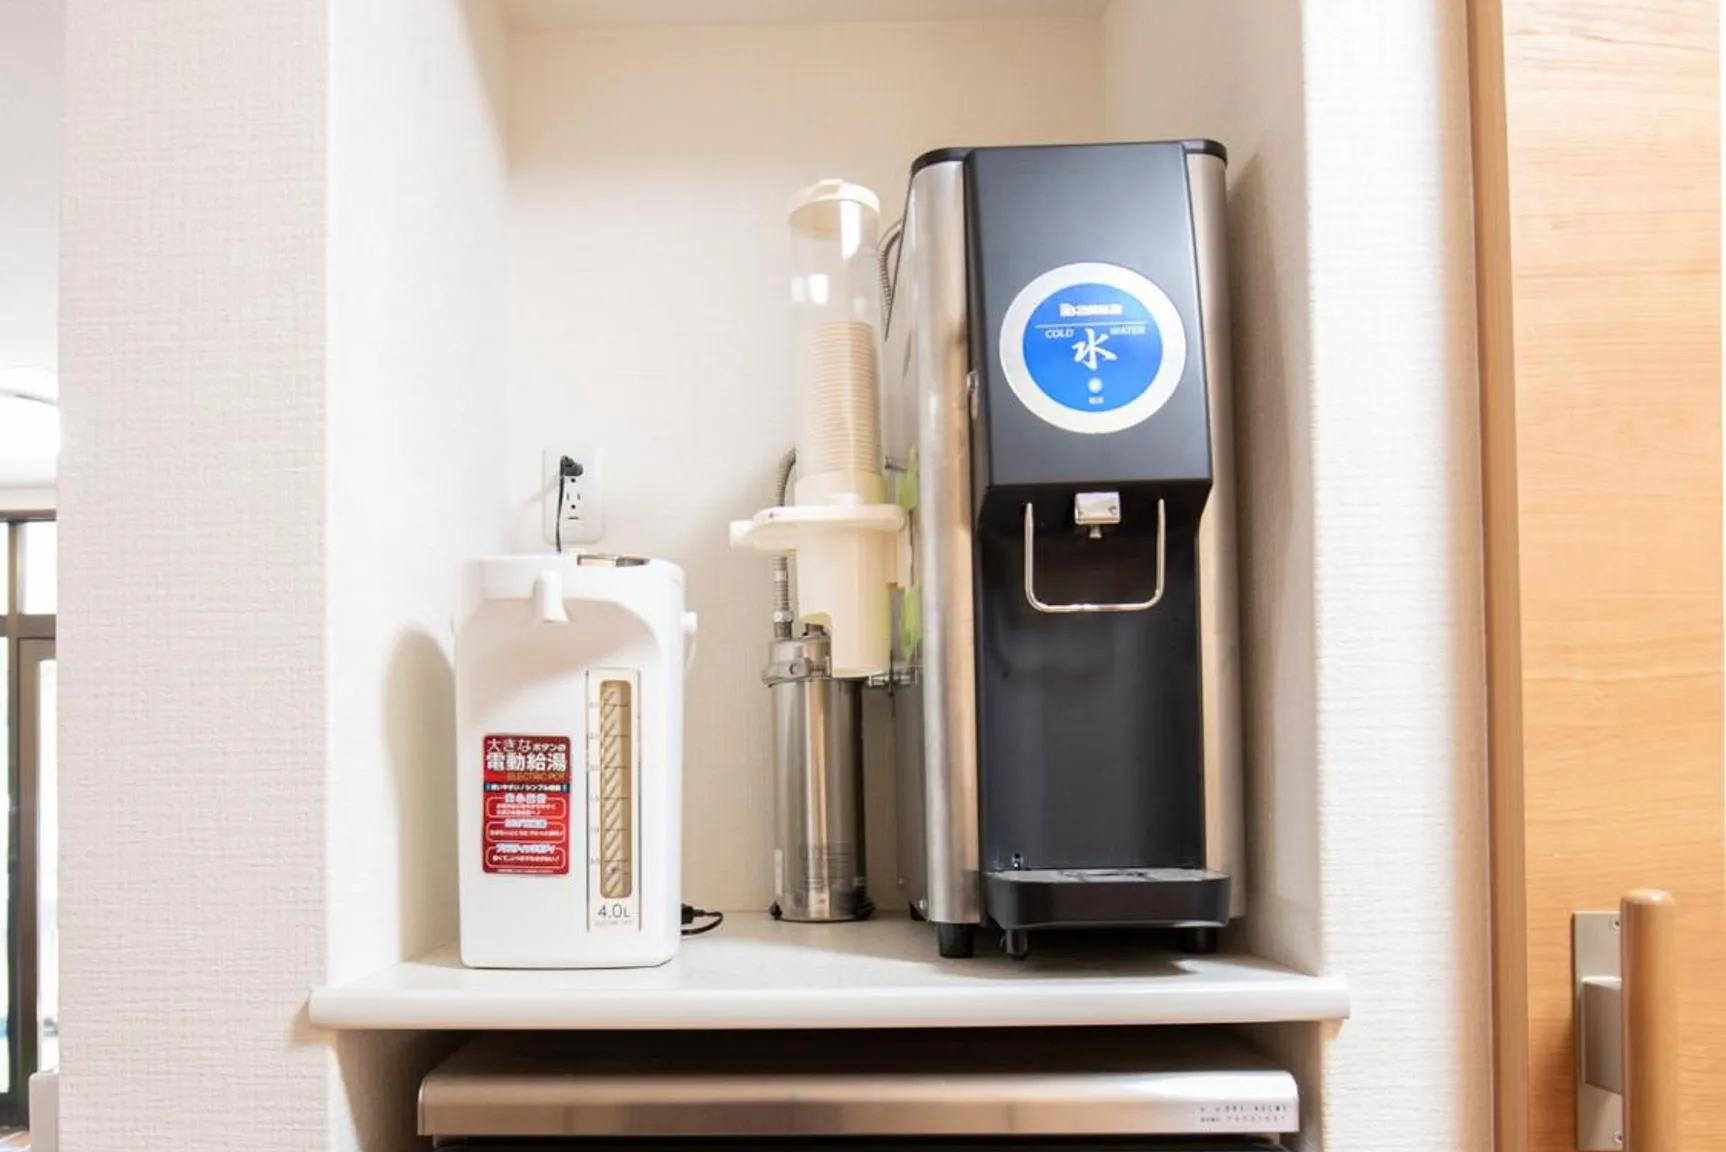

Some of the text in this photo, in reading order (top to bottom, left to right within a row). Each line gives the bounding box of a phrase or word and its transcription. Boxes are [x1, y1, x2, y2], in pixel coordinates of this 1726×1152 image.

[1045, 326, 1146, 339] COLD WATER
[1072, 328, 1118, 370] 水
[487, 752, 566, 772] 電動給湯
